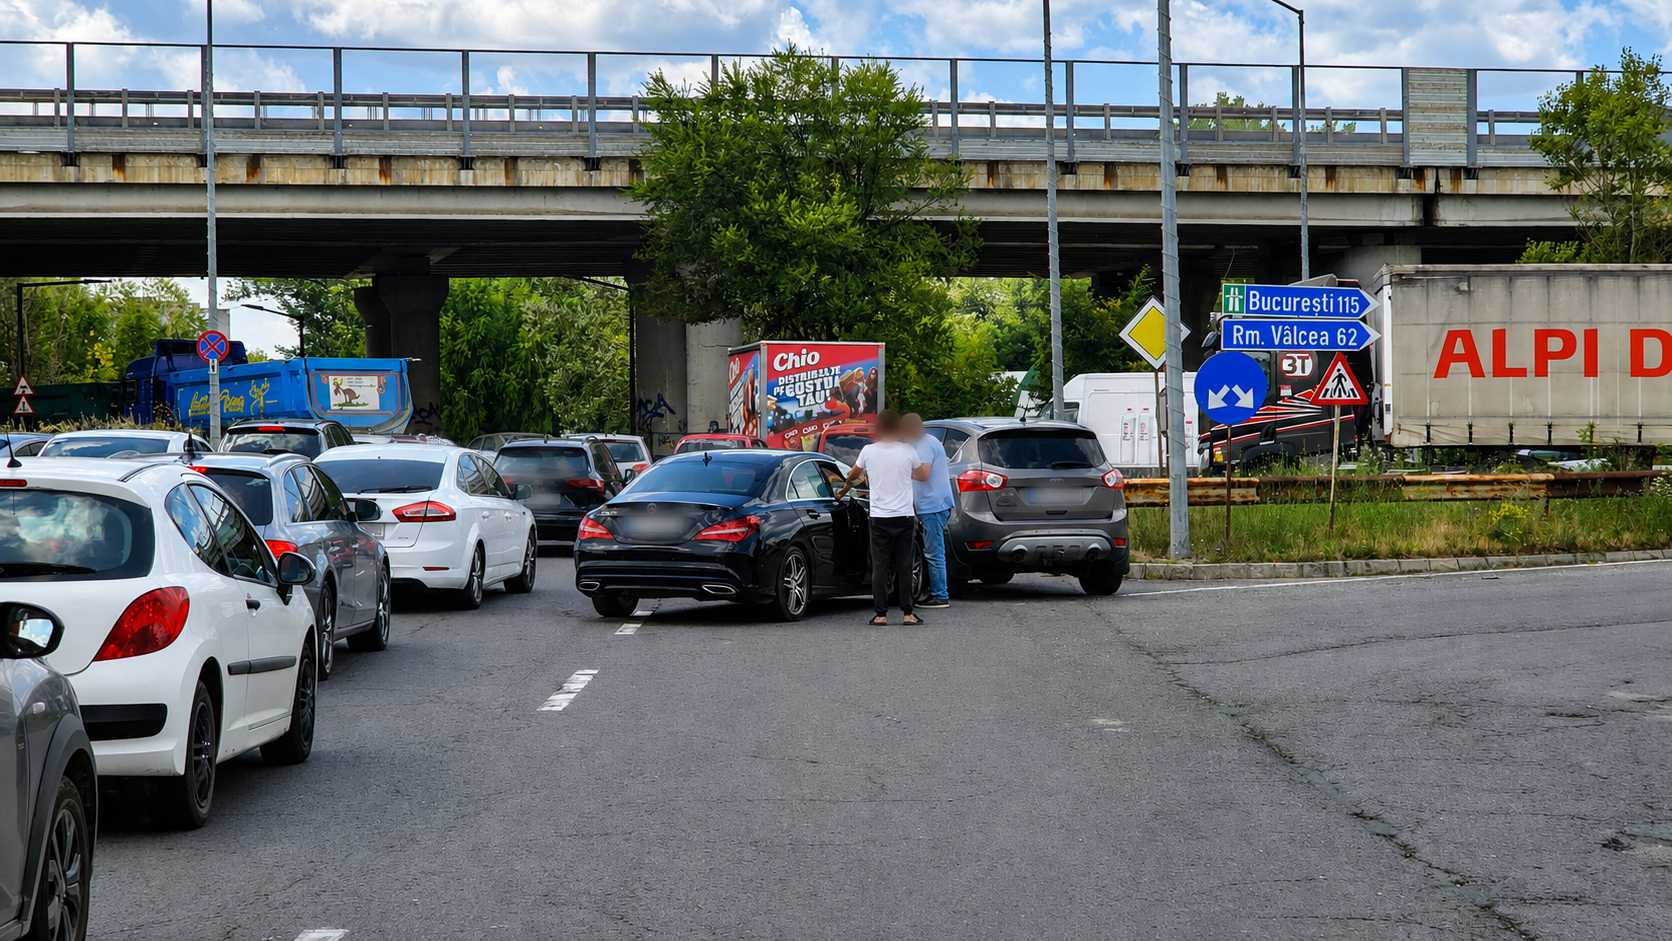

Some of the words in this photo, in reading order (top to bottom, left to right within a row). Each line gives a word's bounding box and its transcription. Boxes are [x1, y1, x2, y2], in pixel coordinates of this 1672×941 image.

[1249, 290, 1334, 316] București
[1337, 296, 1359, 314] 115
[1233, 325, 1265, 345] Rm.
[1271, 325, 1329, 345] Vâlcea
[1337, 328, 1358, 346] 62
[773, 348, 820, 372] Chio
[1282, 355, 1310, 374] 3T
[1433, 328, 1598, 379] ALPI
[1630, 328, 1672, 378] D
